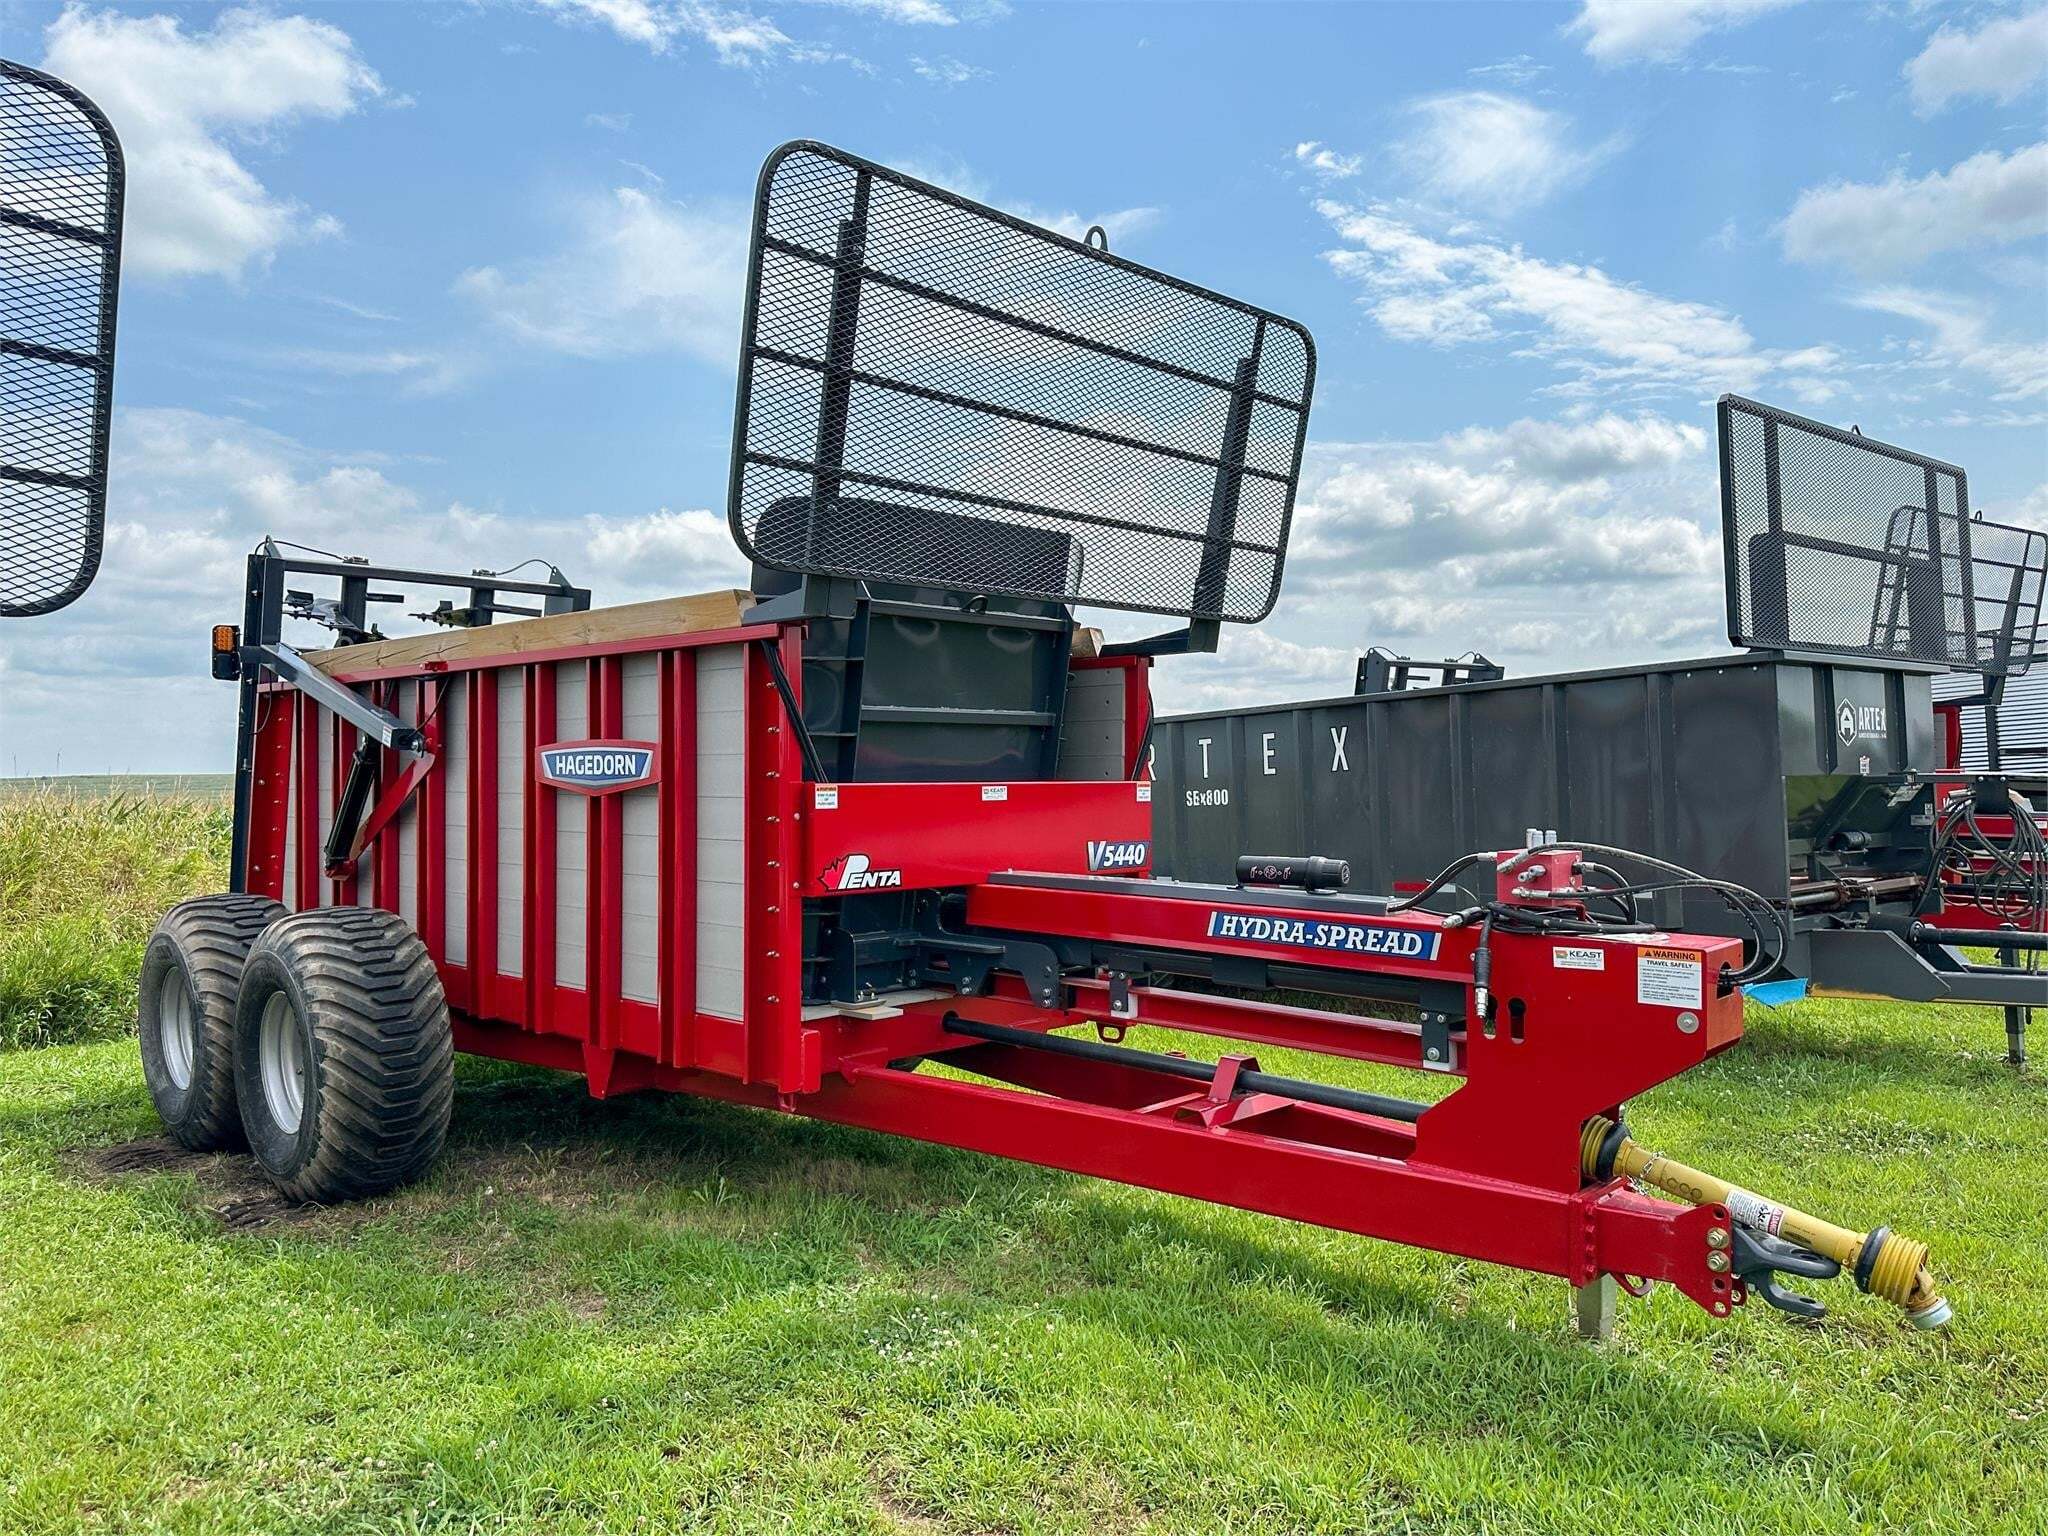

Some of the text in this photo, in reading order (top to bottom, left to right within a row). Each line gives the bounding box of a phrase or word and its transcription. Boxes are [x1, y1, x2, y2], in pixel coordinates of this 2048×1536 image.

[1858, 706, 1887, 731] ARTEX
[555, 754, 636, 775] HAGEDORN
[1186, 788, 1229, 807] SEx800
[1087, 840, 1146, 871] V5440
[837, 854, 901, 890] PENTA
[1220, 915, 1423, 956] HYDRA-SPREAD
[1569, 950, 1602, 959] KEAST
[1646, 959, 1669, 967] TRAVEL
[1652, 950, 1696, 961] WARNING
